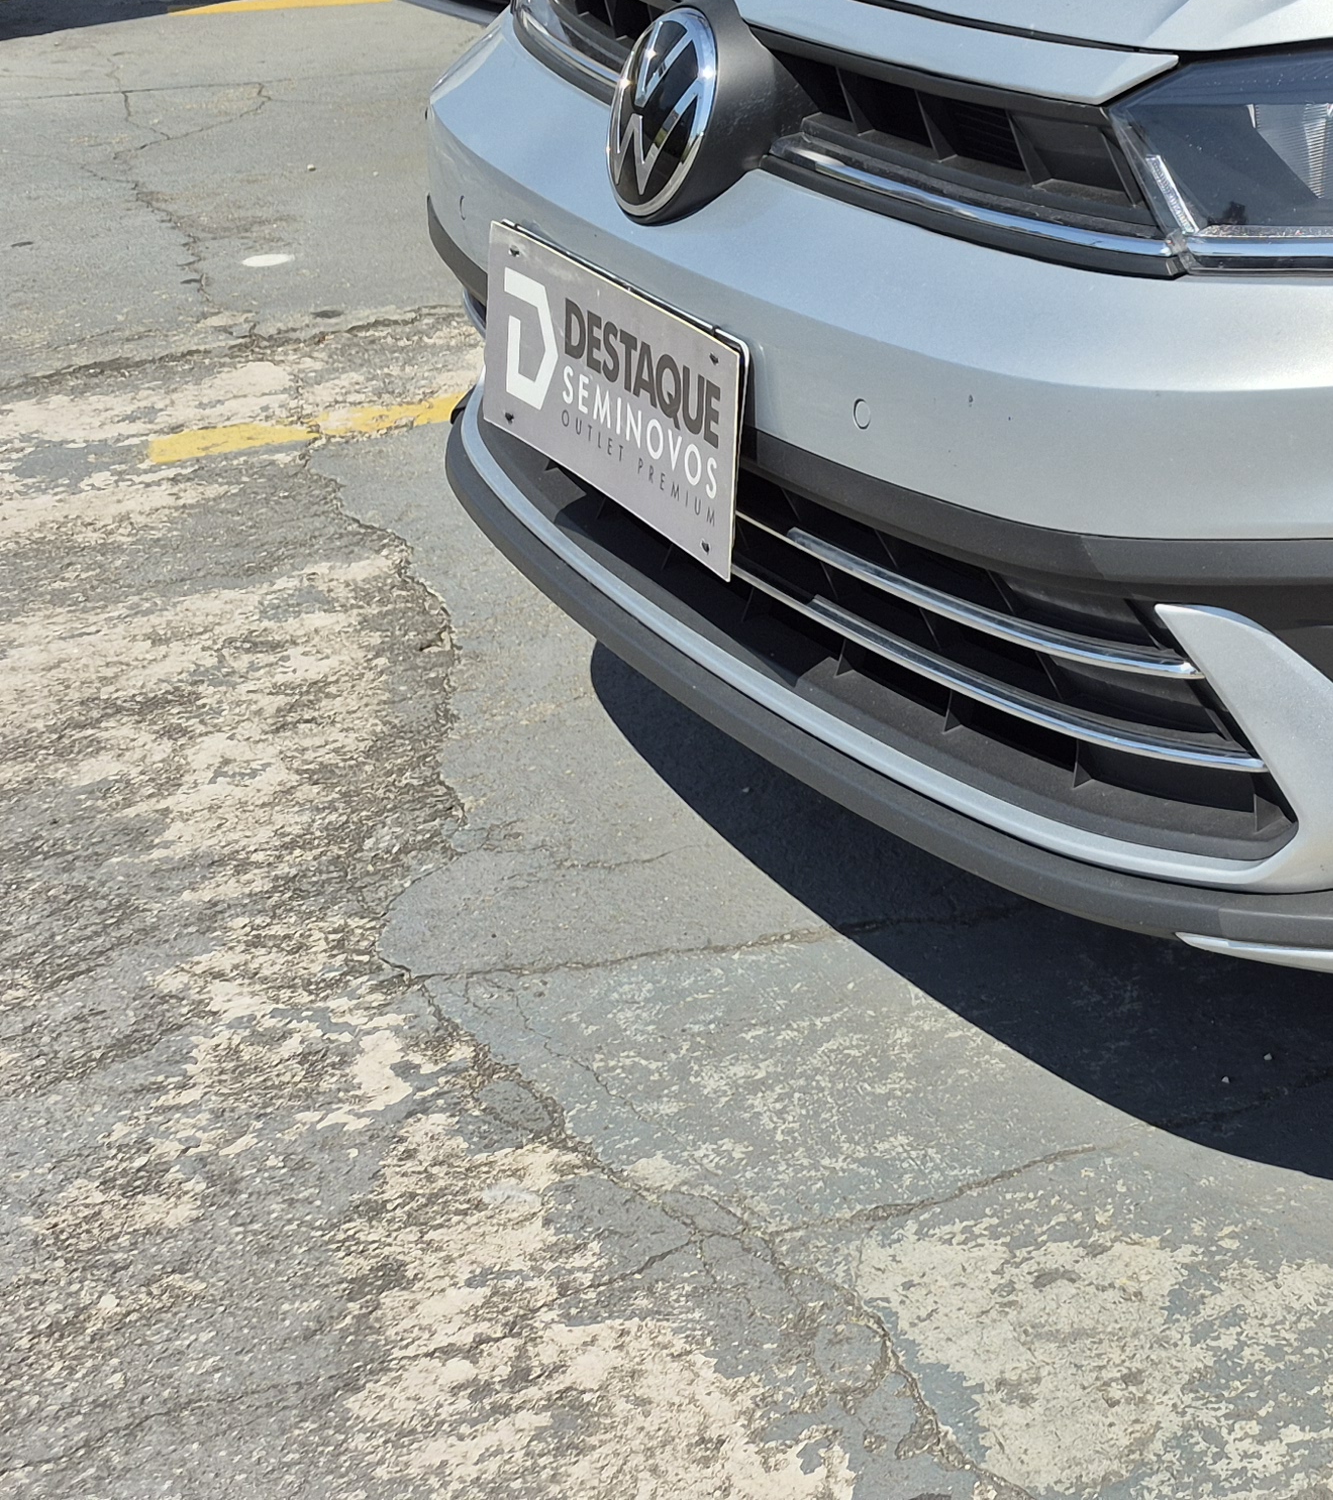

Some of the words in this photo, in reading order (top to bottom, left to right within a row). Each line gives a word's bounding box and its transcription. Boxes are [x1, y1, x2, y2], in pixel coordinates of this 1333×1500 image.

[561, 365, 717, 500] SEMINOVOS
[563, 298, 721, 449] DESTAQUE
[561, 412, 625, 463] OUTLET
[637, 457, 716, 528] PREMIUM
